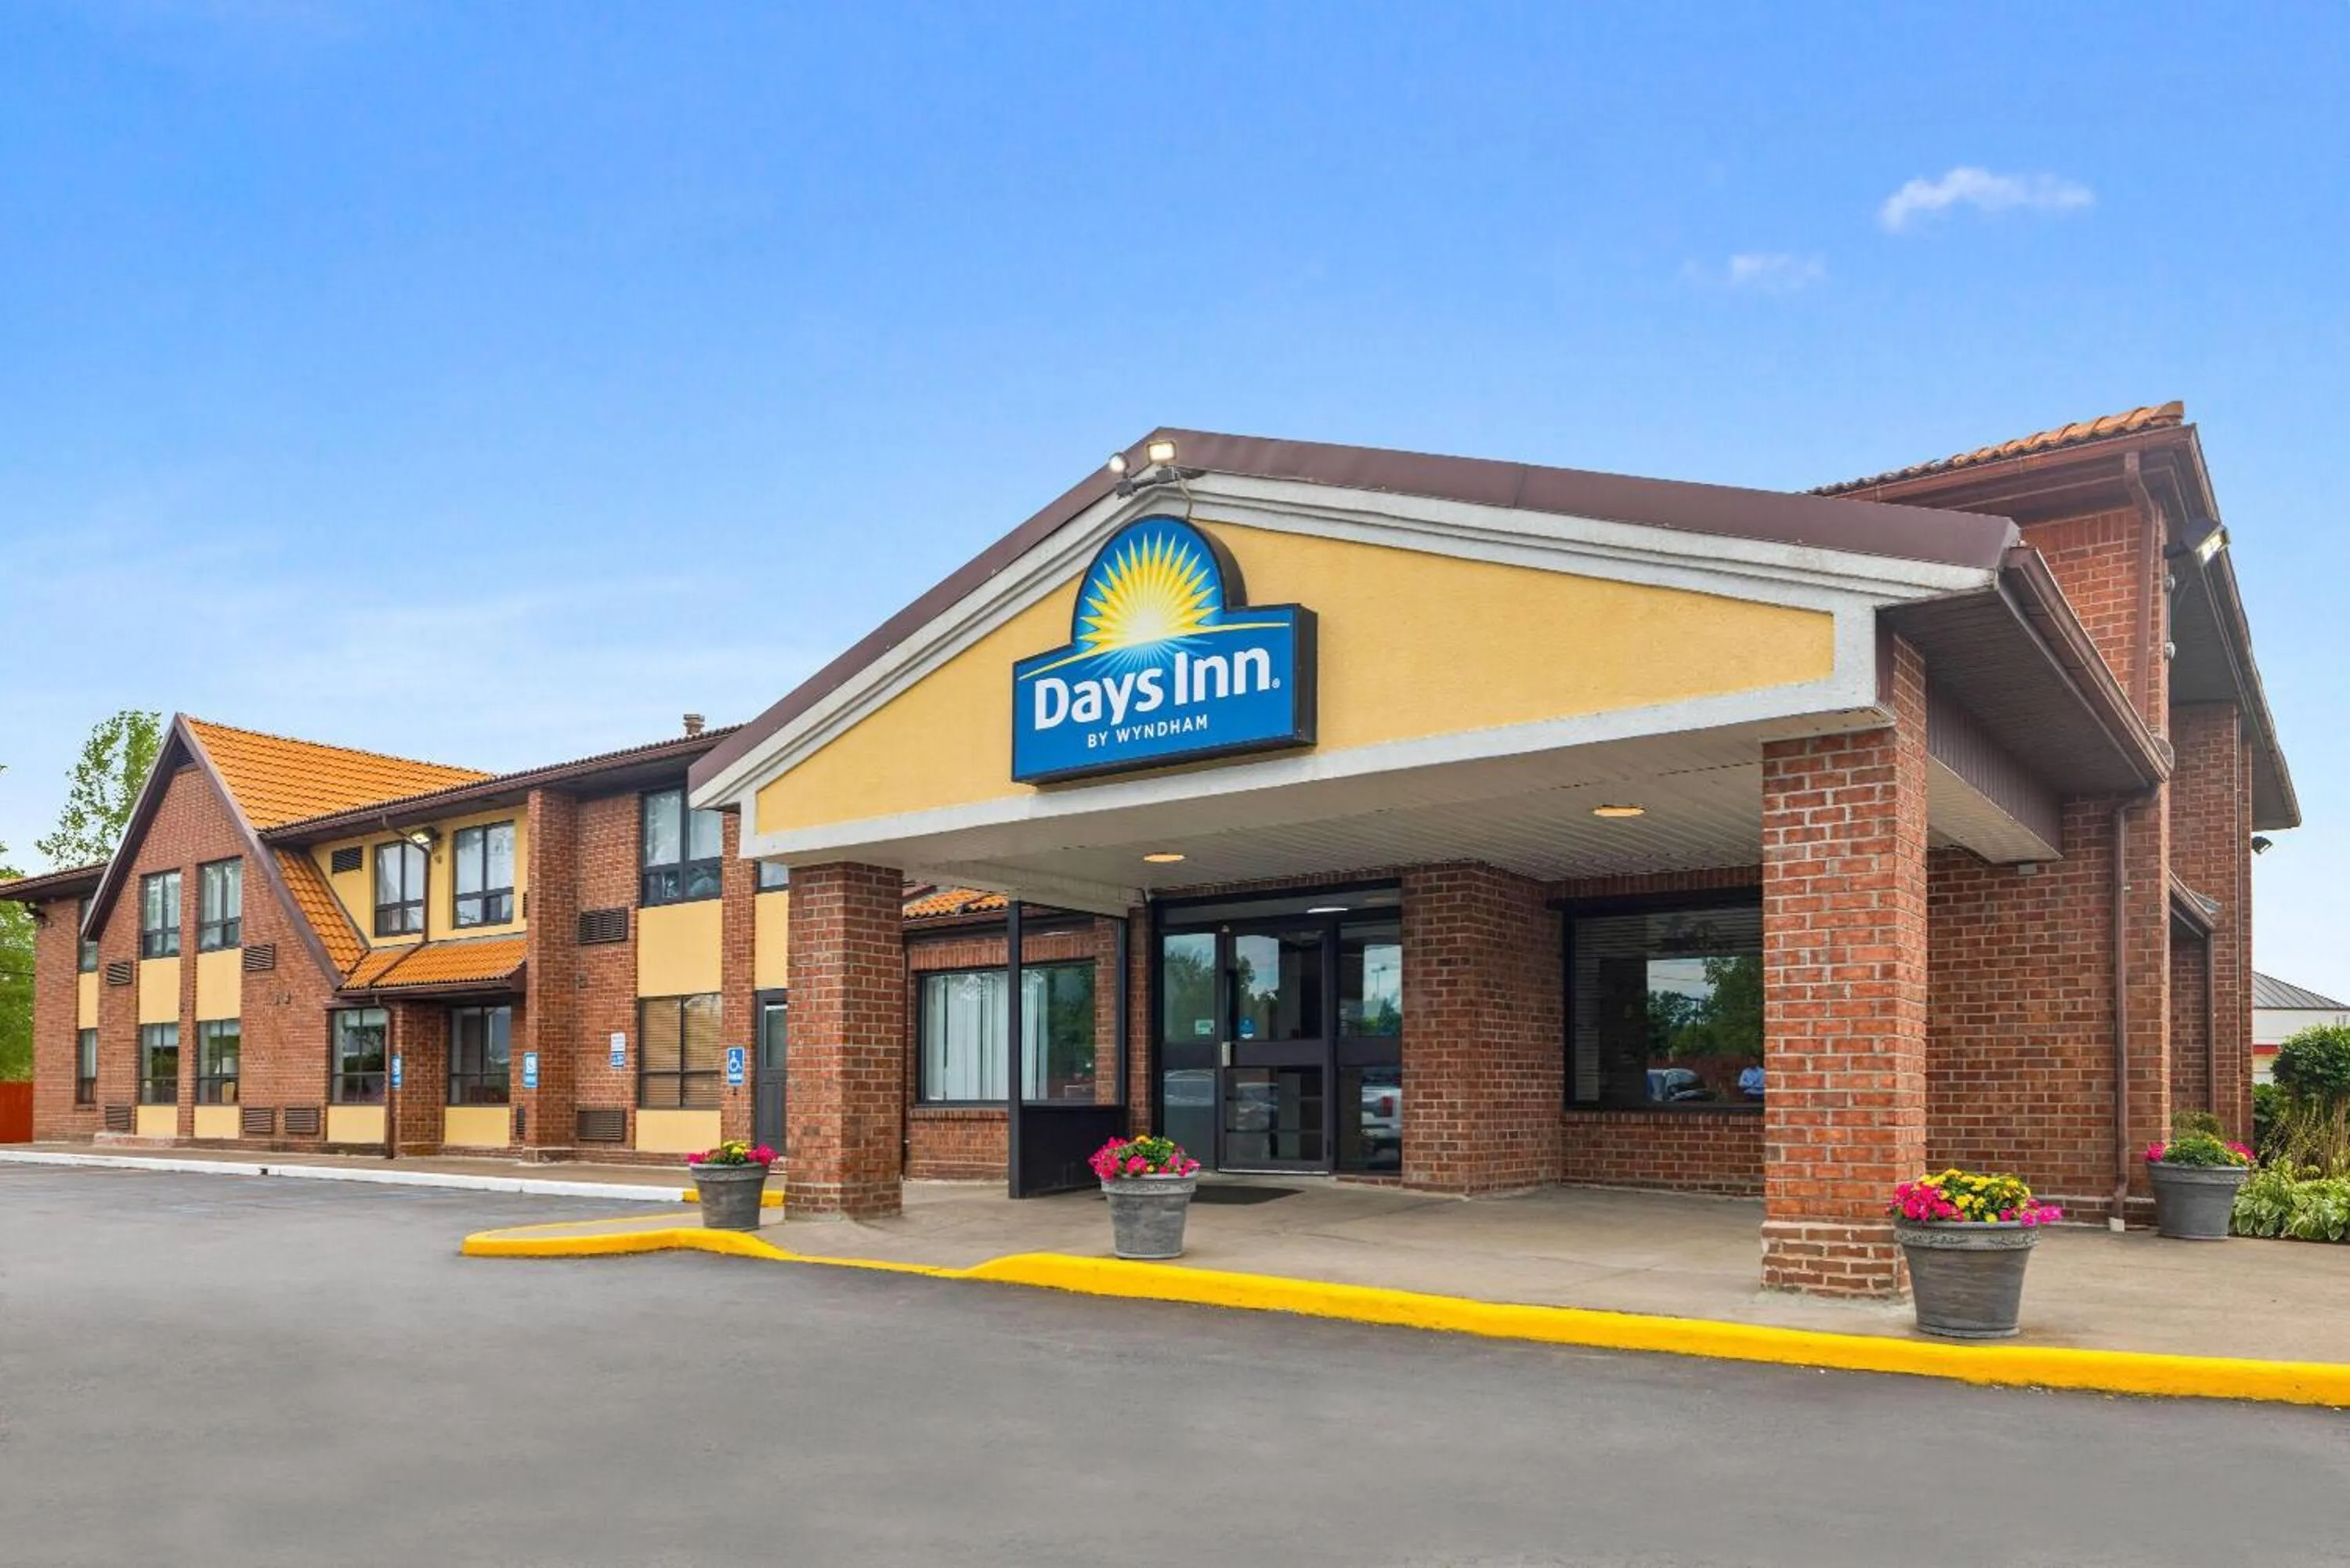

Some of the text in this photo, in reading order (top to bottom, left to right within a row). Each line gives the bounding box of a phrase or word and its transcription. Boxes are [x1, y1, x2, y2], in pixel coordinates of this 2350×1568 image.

[1035, 667, 1164, 731] Days
[1087, 714, 1208, 749] BY WYNDHAM
